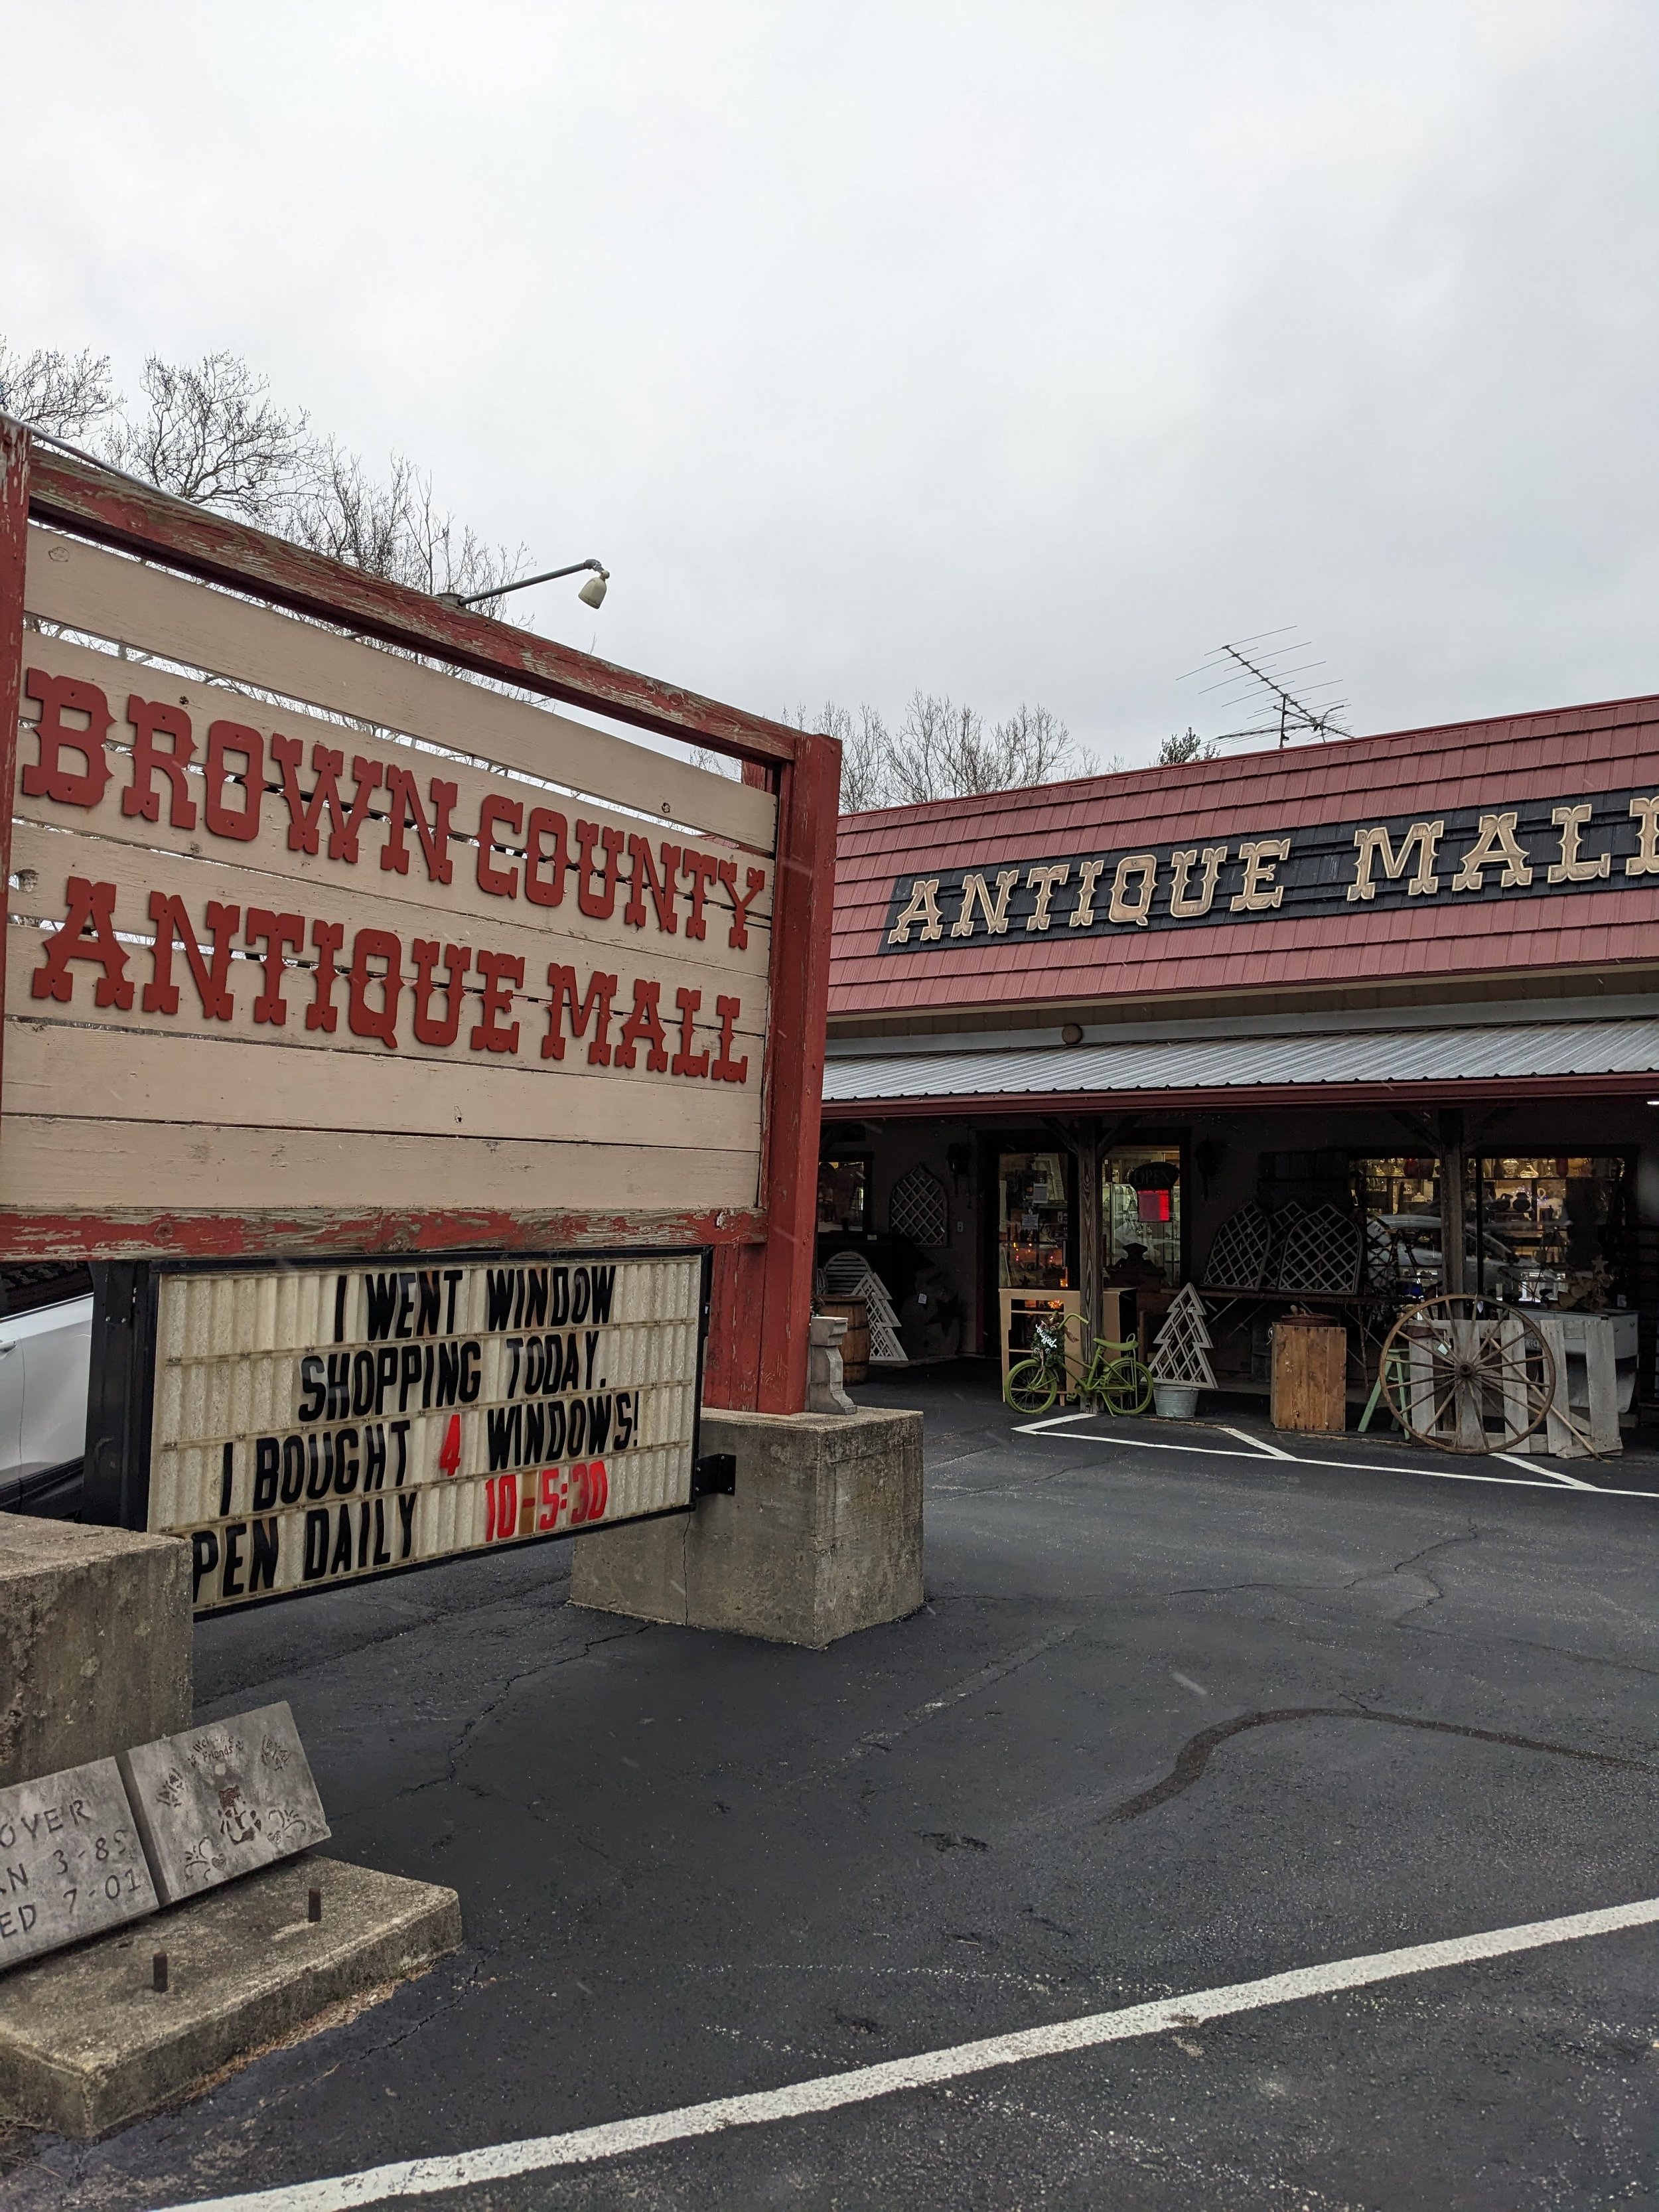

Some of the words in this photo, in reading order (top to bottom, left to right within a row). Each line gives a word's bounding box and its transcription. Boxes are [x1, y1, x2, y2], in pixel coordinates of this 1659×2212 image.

[21, 666, 458, 885] BROWN
[476, 794, 764, 950] COUNTY
[888, 838, 1291, 944] ANTIQUE
[32, 876, 526, 1054] ANTIQUE
[540, 962, 749, 1083] MALL
[334, 1274, 346, 1342] I
[366, 1270, 463, 1341] WENT
[486, 1266, 616, 1331] WINDOW
[298, 1341, 481, 1422] SHOPPING
[506, 1331, 606, 1399] TODAY.
[220, 1442, 233, 1516] I
[252, 1420, 410, 1512] BOUGHT
[439, 1414, 461, 1477] 4
[488, 1392, 638, 1471] WINDOWS!
[192, 1516, 279, 1603] PEN
[303, 1492, 417, 1582] DAILY
